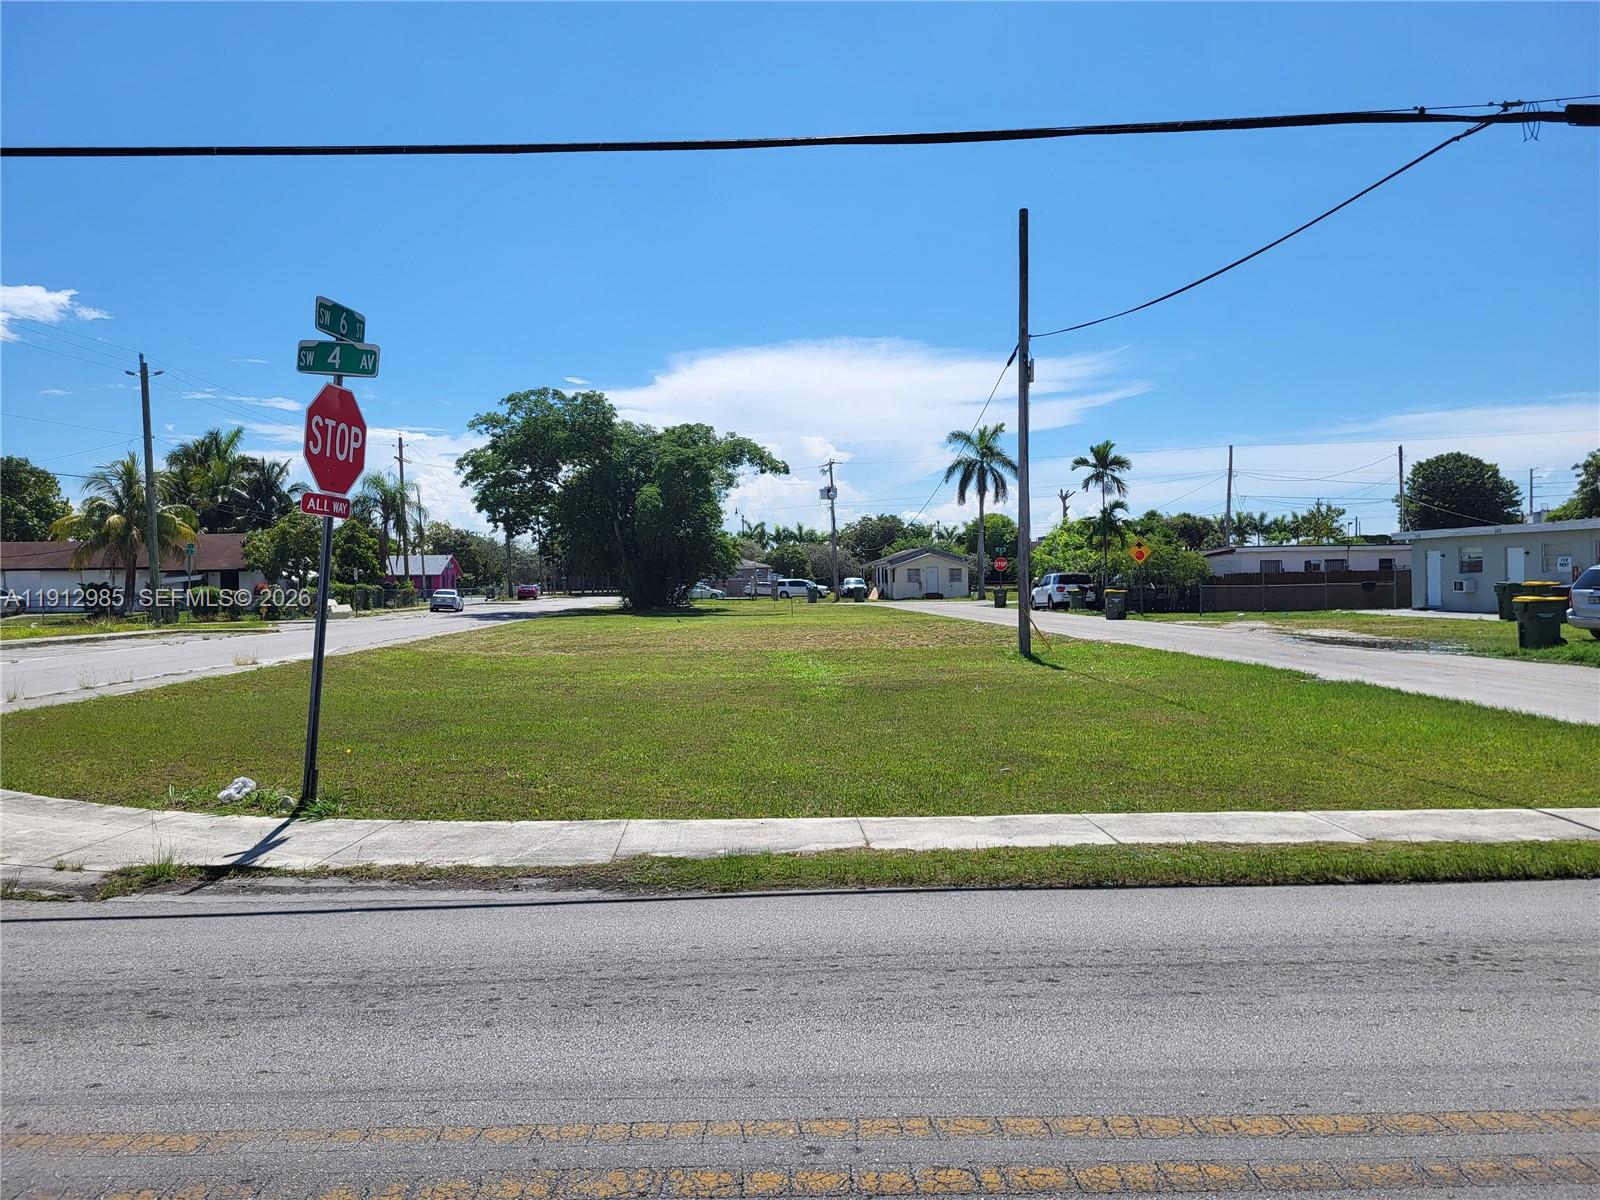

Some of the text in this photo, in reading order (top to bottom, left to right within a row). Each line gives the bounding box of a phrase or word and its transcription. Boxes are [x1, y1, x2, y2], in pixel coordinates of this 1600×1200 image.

[319, 307, 364, 339] SW 6 ST
[299, 346, 375, 370] SW 4 AV
[309, 414, 363, 463] STOP
[307, 498, 348, 515] ALL WAY
